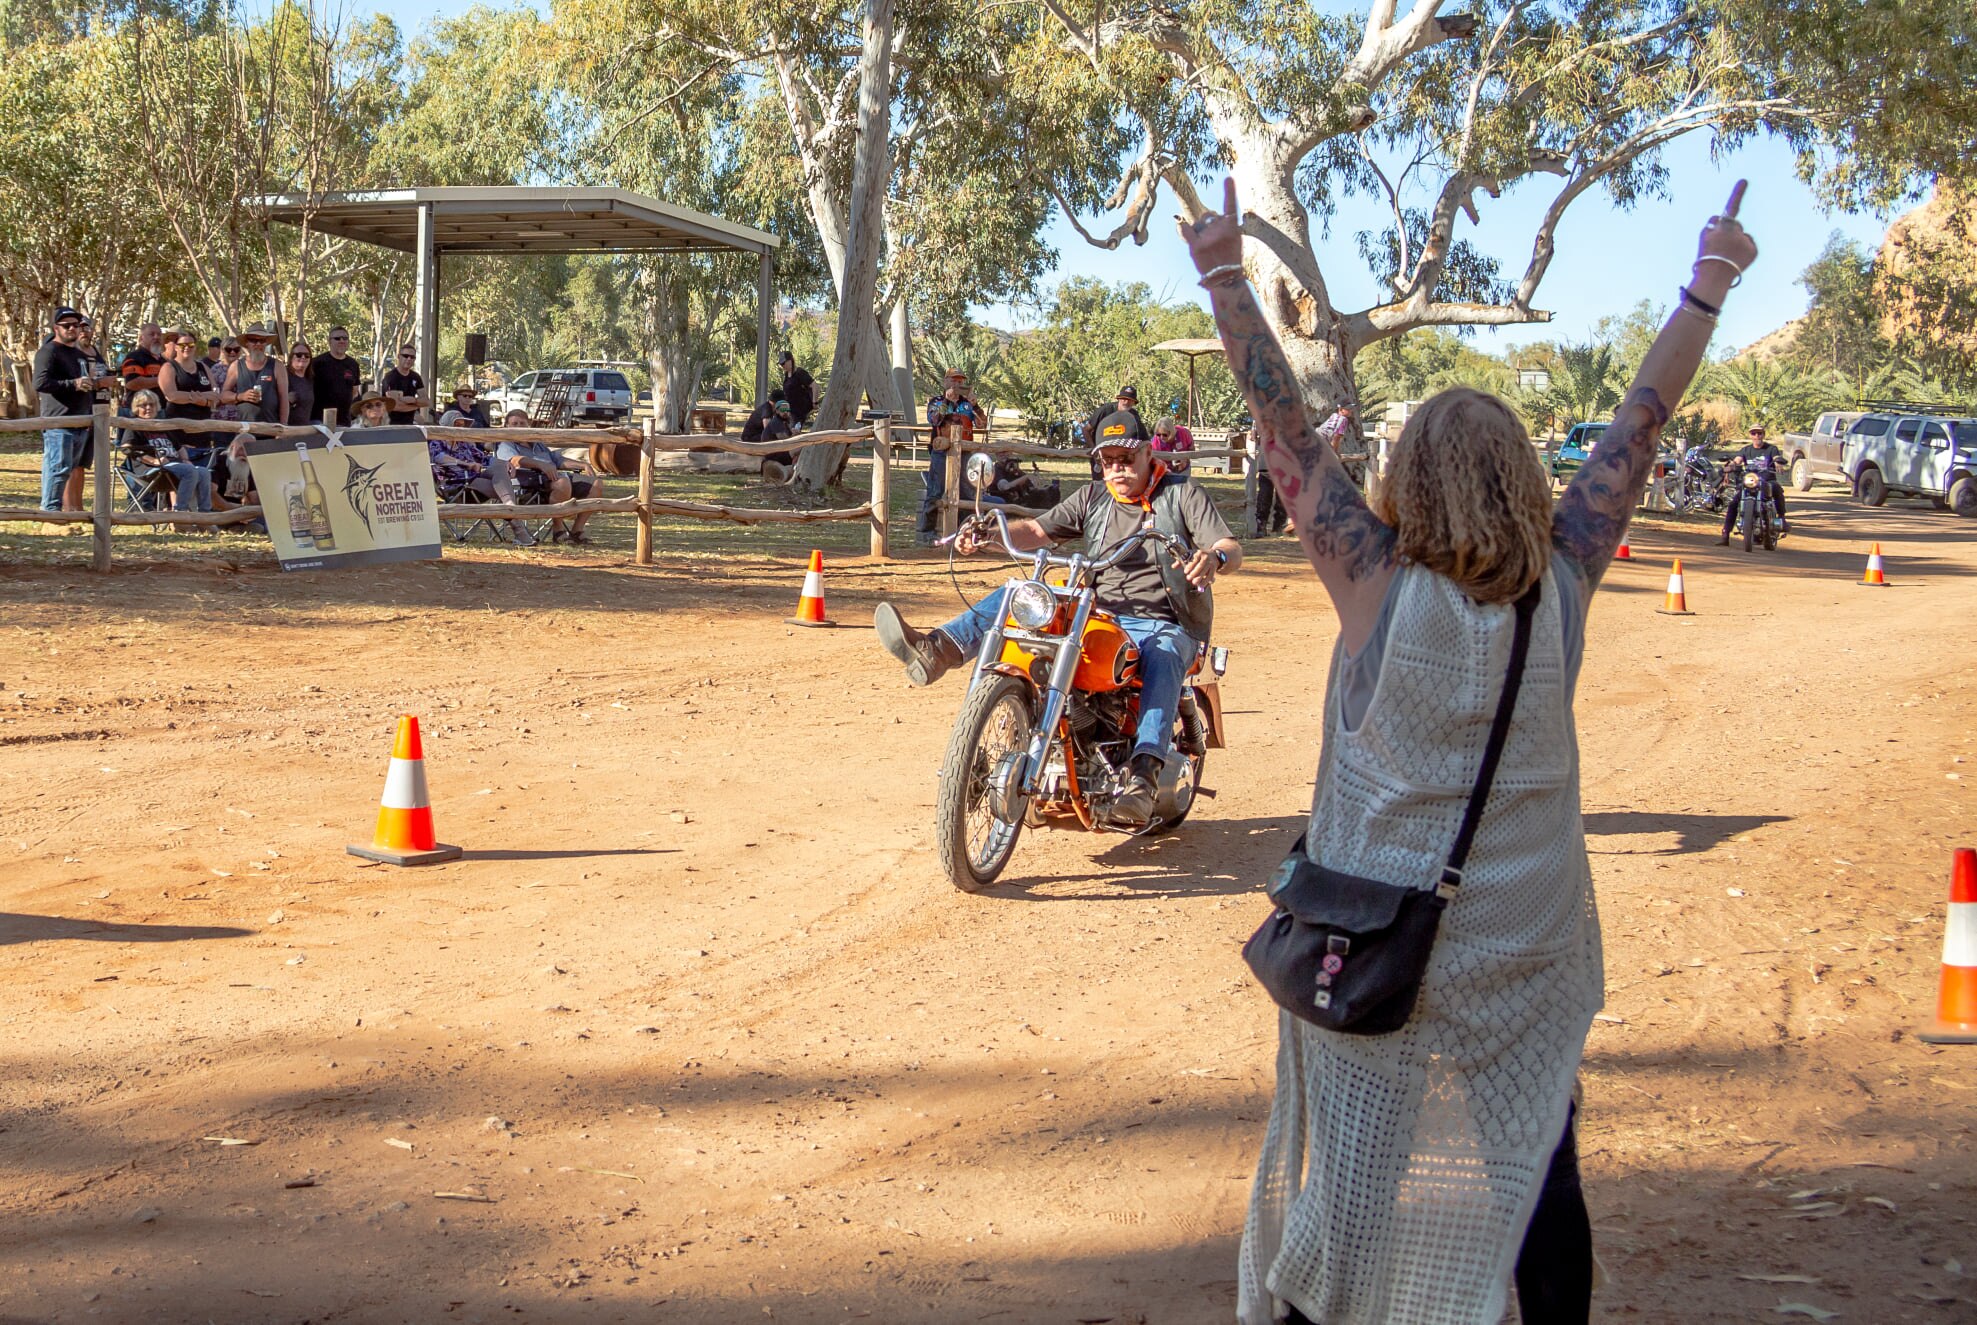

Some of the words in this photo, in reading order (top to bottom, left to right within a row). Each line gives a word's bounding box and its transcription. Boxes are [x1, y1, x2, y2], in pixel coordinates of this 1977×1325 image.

[372, 481, 419, 502] GREAT
[375, 501, 424, 516] NORTHERN
[385, 514, 410, 524] BREWING
